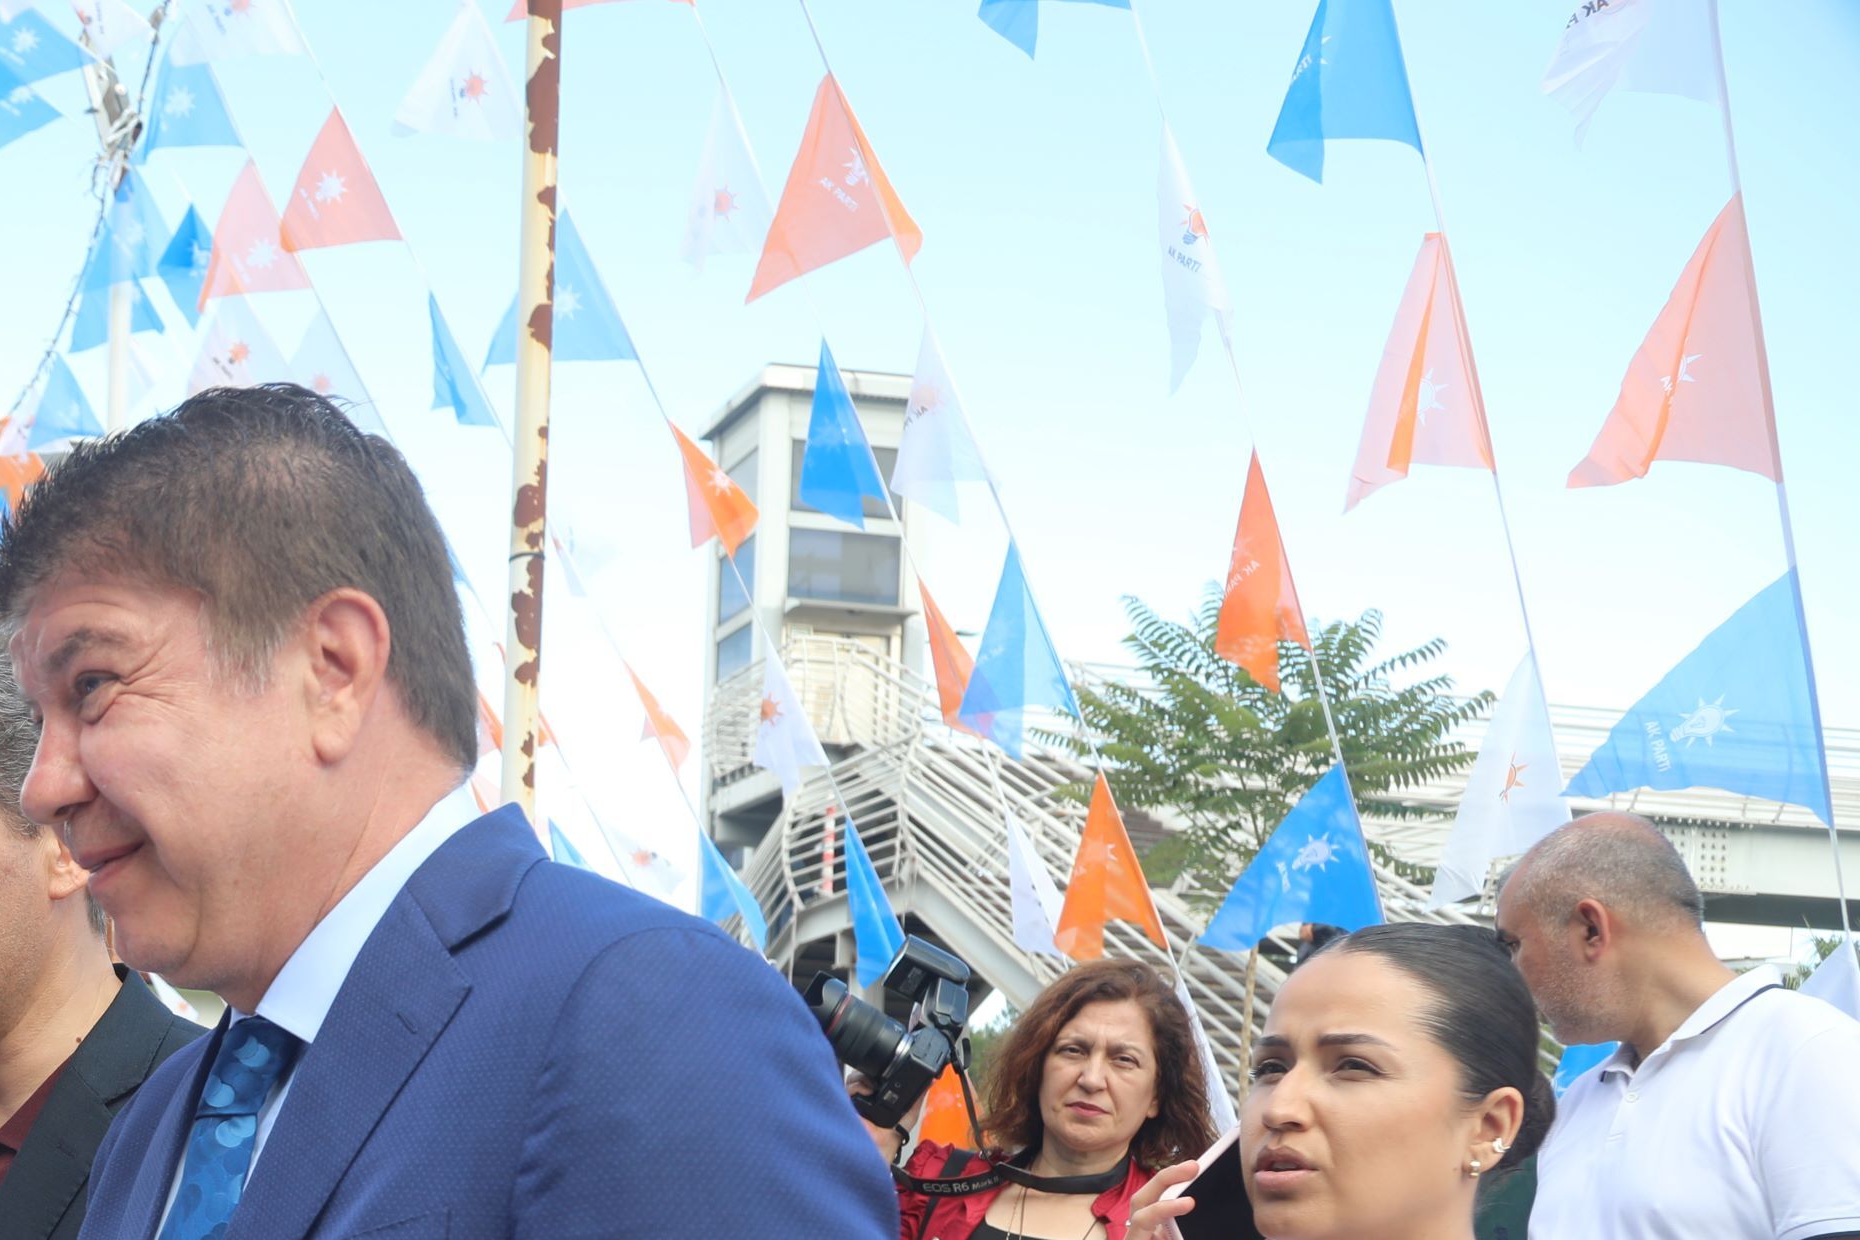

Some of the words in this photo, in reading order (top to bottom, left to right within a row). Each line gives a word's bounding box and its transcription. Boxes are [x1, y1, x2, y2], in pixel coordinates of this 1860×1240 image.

[1643, 720, 1662, 739] AK
[922, 1182, 952, 1194] EOS
[952, 1182, 970, 1193] R6
[971, 1179, 993, 1191] Mark
